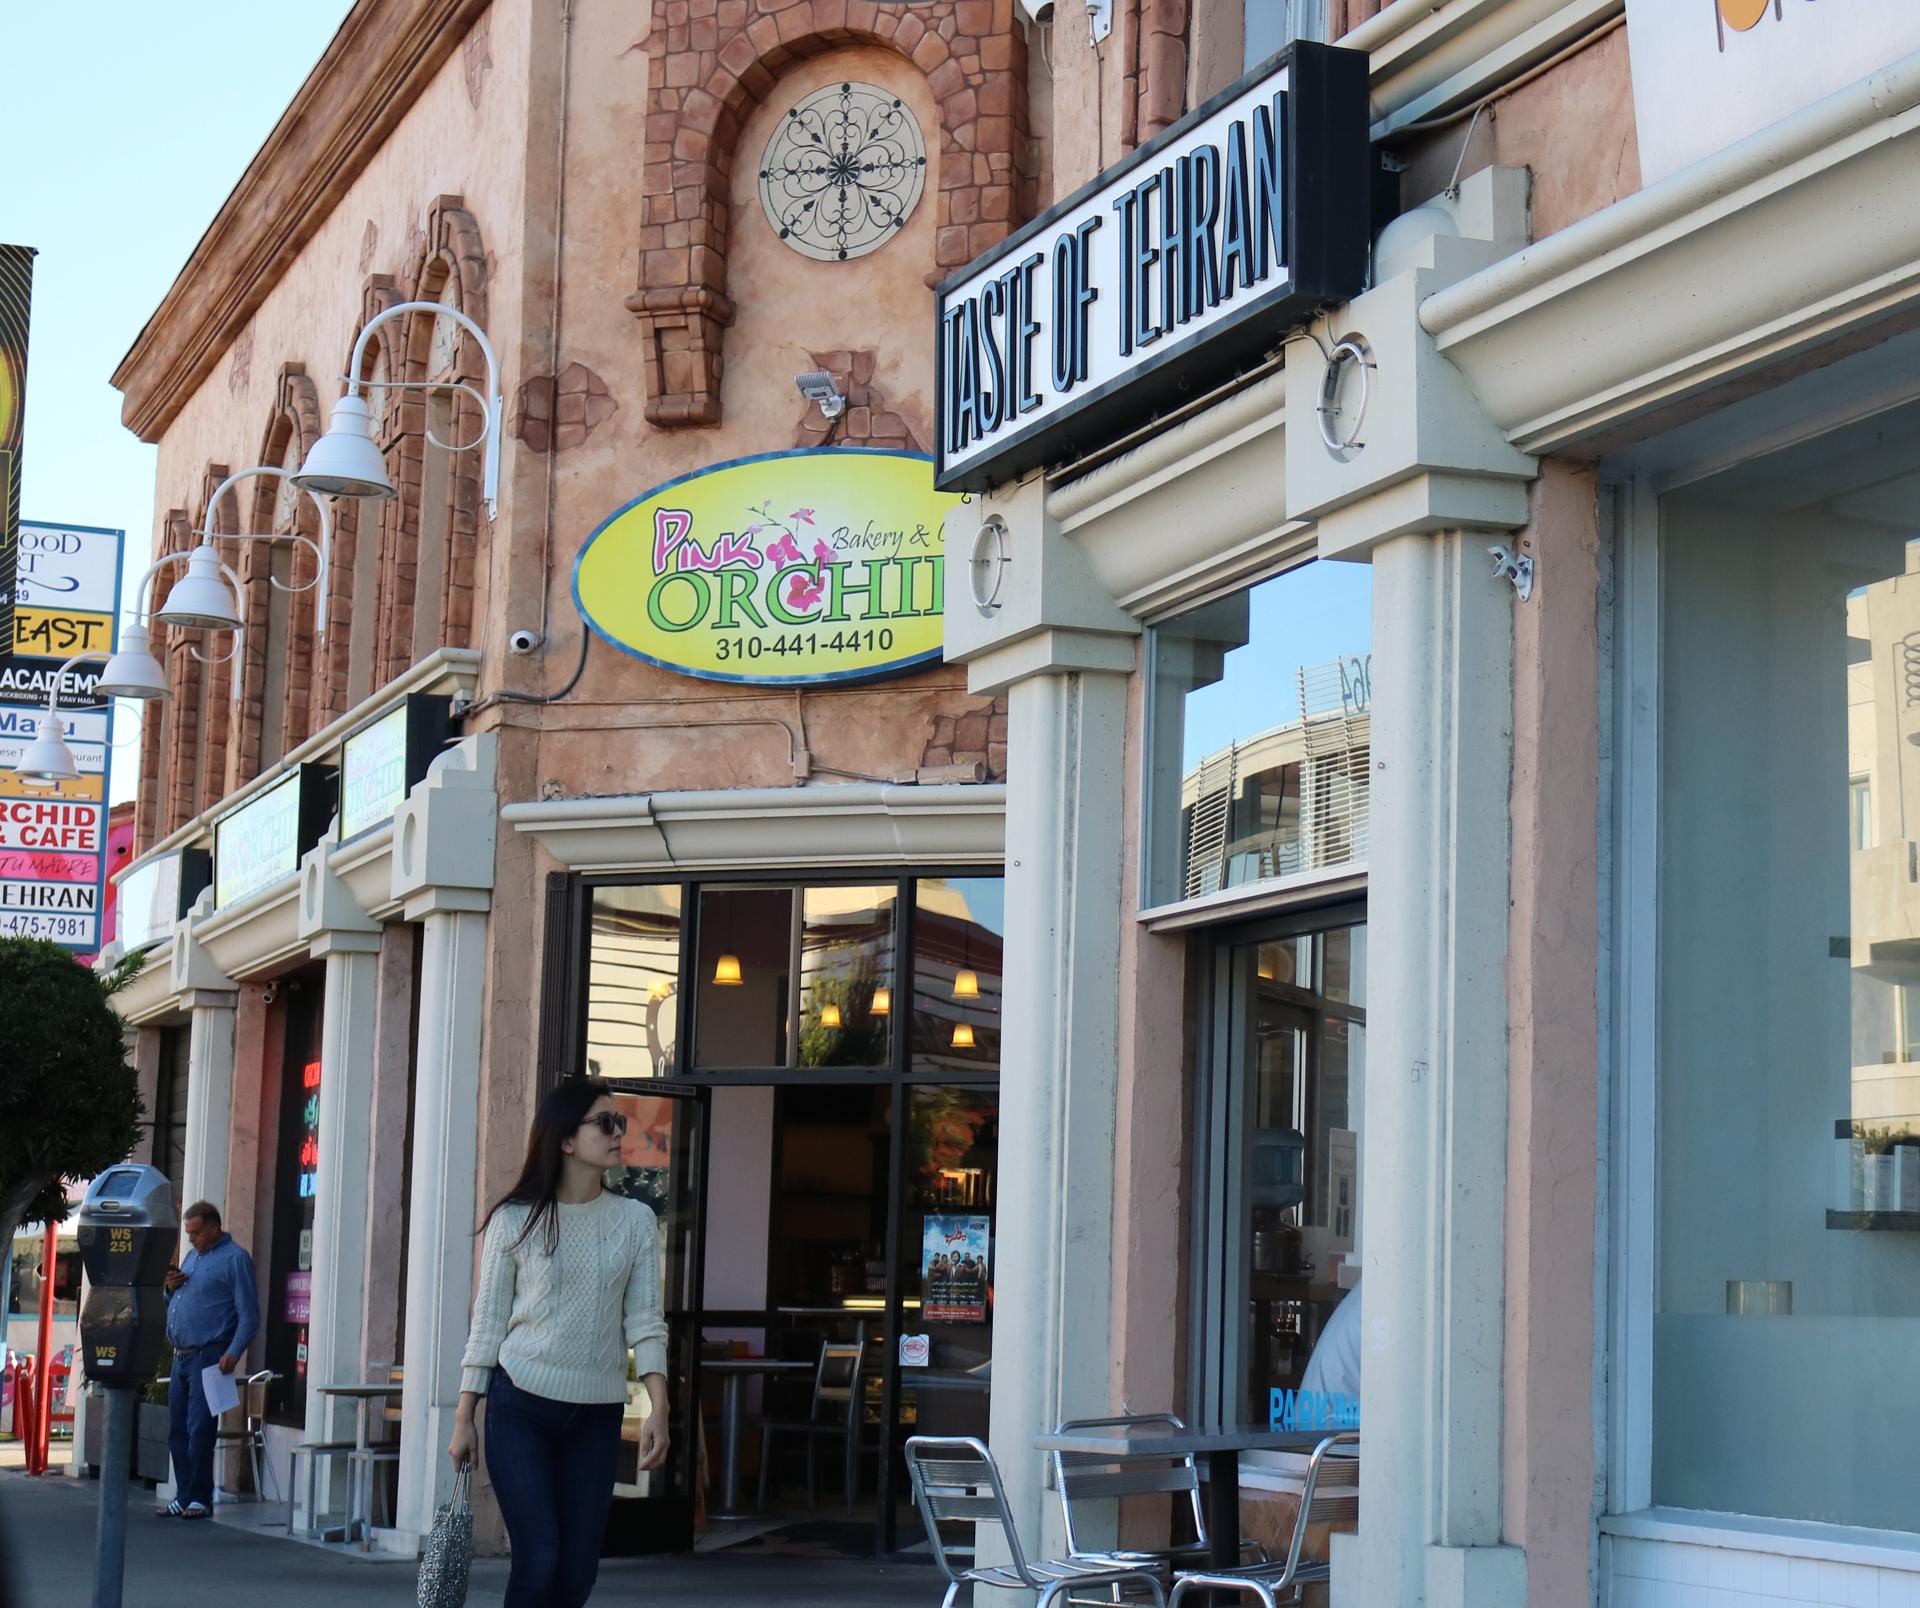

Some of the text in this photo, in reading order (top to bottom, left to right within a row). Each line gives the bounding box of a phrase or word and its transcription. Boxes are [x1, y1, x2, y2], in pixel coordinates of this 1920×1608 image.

[943, 90, 1288, 454] TASTE OF TEHRAN
[832, 520, 903, 558] Bakery
[909, 524, 930, 543] &
[15, 615, 104, 653] EAST
[715, 628, 894, 661] 310-441-4410
[78, 696, 96, 705] MAGA
[20, 825, 95, 849] CAFE
[0, 855, 94, 876] TU MADRE
[110, 1228, 132, 1240] WS
[110, 1240, 132, 1253] 251
[95, 1346, 117, 1359] WS
